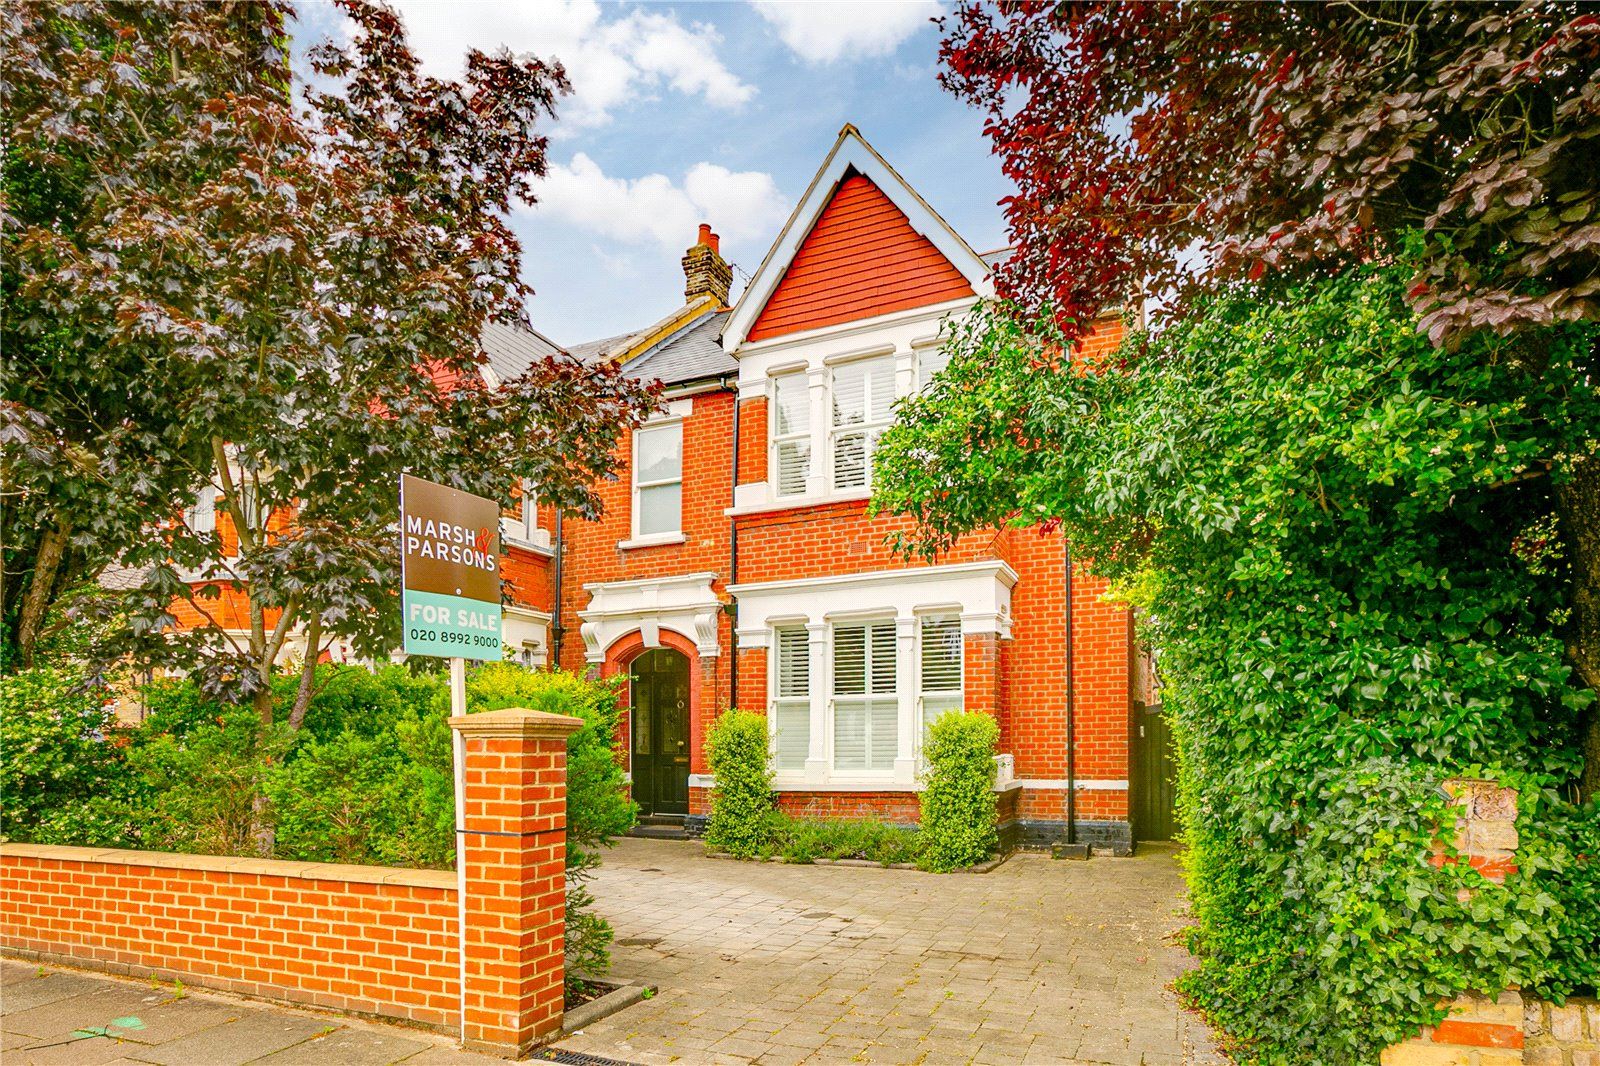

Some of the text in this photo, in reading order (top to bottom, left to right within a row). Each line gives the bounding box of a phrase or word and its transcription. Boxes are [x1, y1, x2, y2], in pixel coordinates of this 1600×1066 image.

[407, 515, 495, 560] MARSH &
[407, 536, 495, 571] PARSONS
[410, 603, 498, 631] FOR SALE
[410, 628, 499, 648] 020 8992 9000
